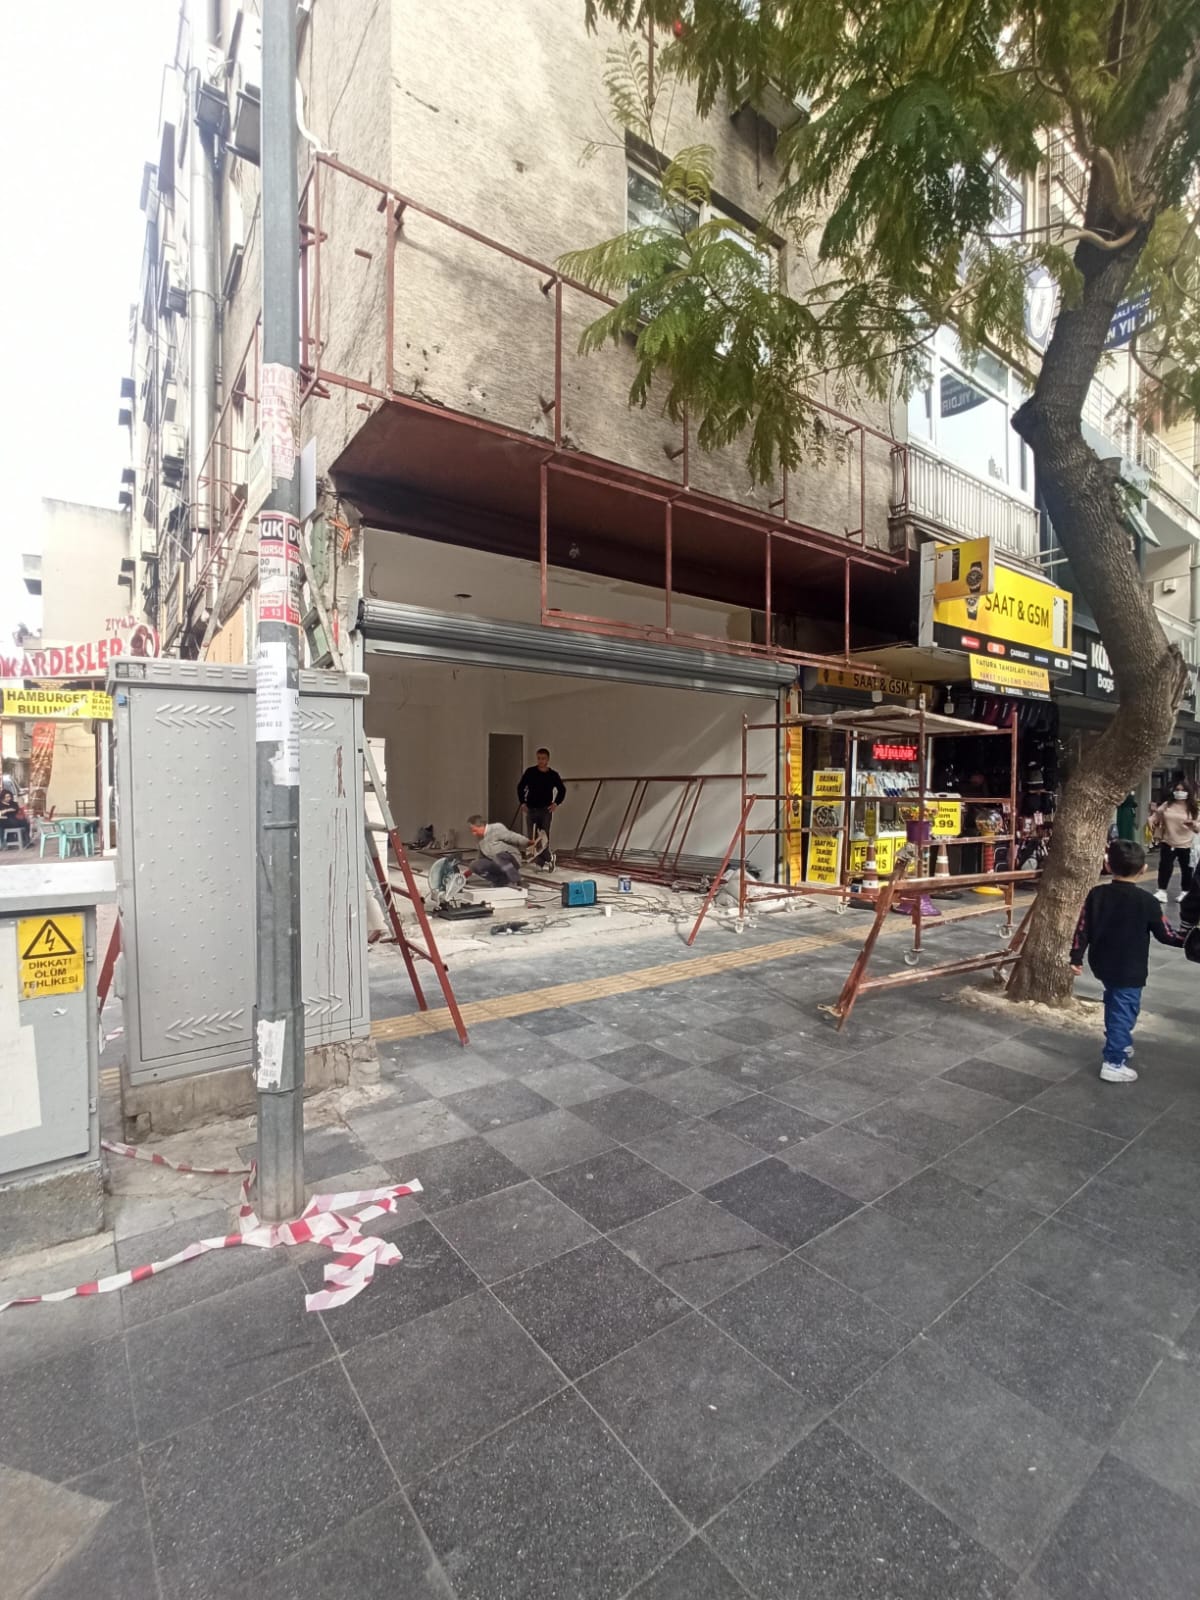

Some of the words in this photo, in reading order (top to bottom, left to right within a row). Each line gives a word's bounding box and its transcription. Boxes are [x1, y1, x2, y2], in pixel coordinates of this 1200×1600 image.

[985, 592, 1015, 617] SAAT
[1017, 600, 1025, 621] &
[1027, 604, 1049, 628] GSM
[853, 673, 876, 689] SAAT
[880, 678, 886, 691] &
[889, 680, 909, 696] GSM
[24, 973, 78, 989] TEHLİKESİ
[34, 968, 67, 979] ÖLÜM
